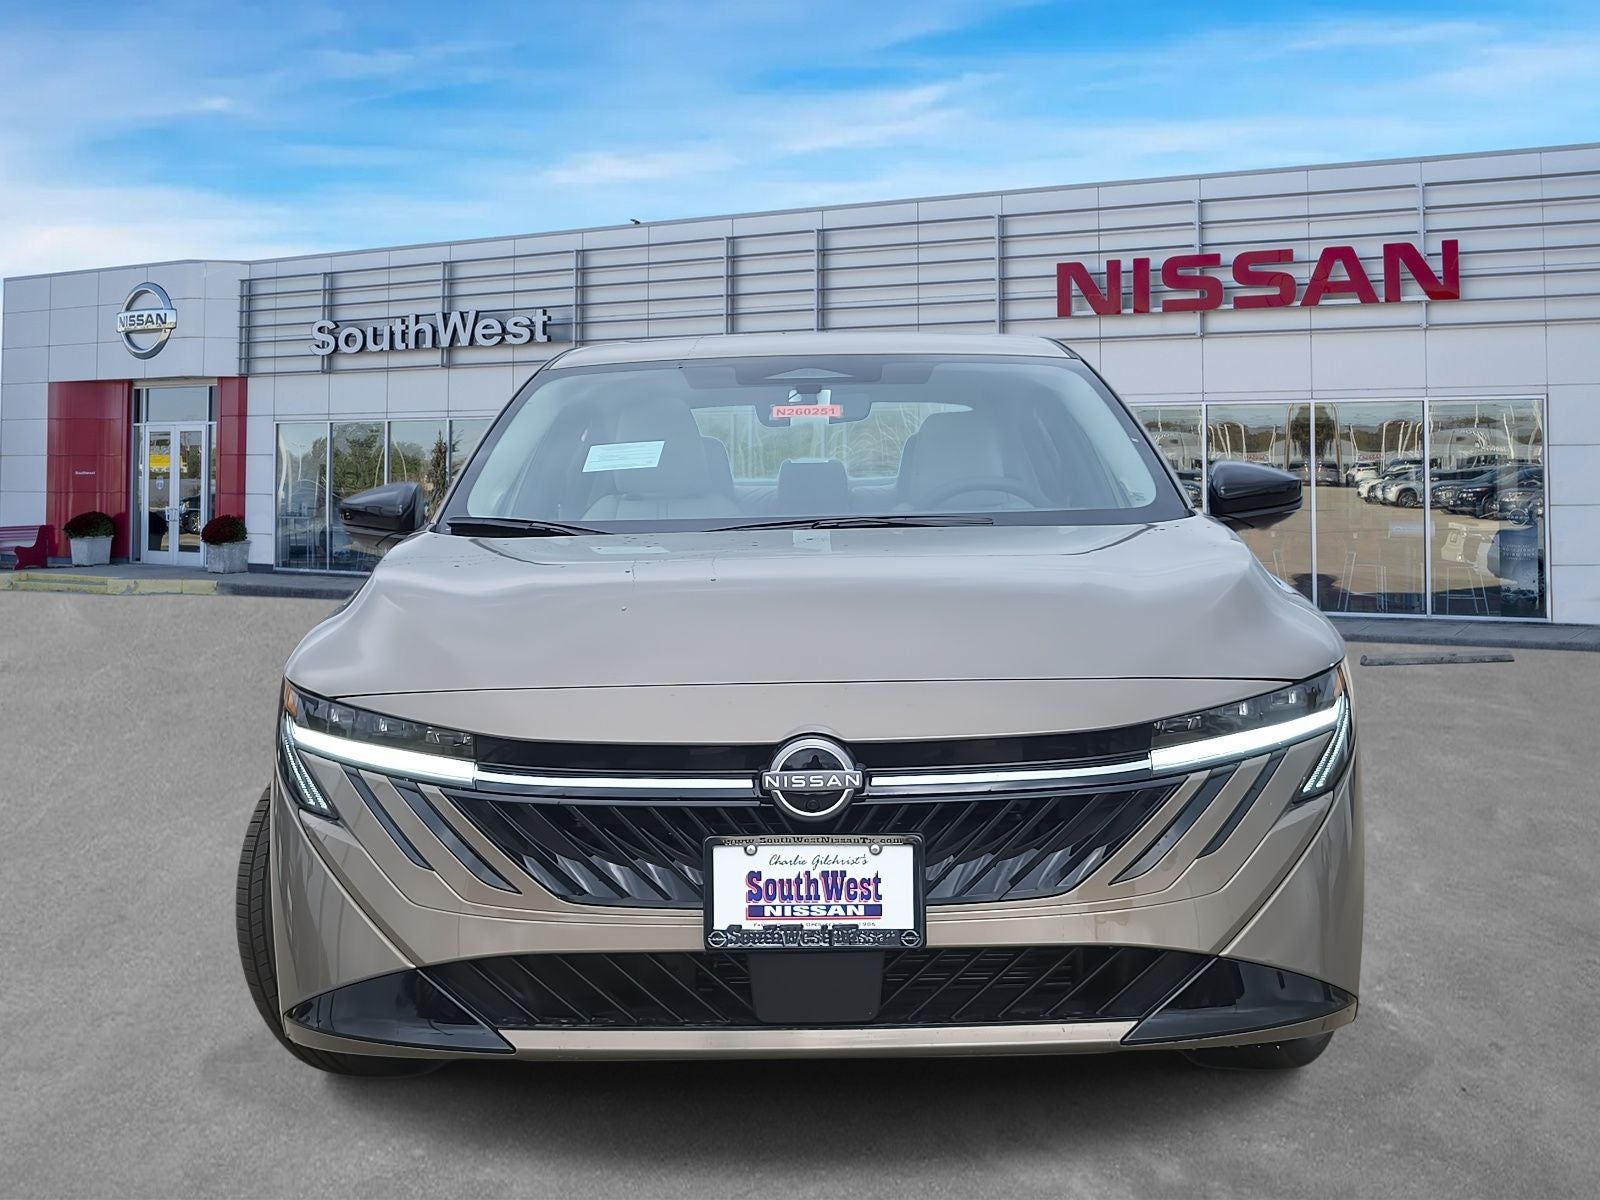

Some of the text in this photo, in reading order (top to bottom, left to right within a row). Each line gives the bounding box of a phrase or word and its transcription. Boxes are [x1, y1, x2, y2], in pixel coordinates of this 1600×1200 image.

[1057, 239, 1460, 317] NISSAN
[119, 312, 167, 327] NISSAN
[309, 308, 551, 355] SouthWest
[776, 407, 836, 416] N260251
[765, 774, 860, 788] NISSAN
[768, 853, 868, 870] Charlie Gilchrist's
[745, 870, 882, 903] SouthWest
[763, 905, 865, 917] NISSAN
